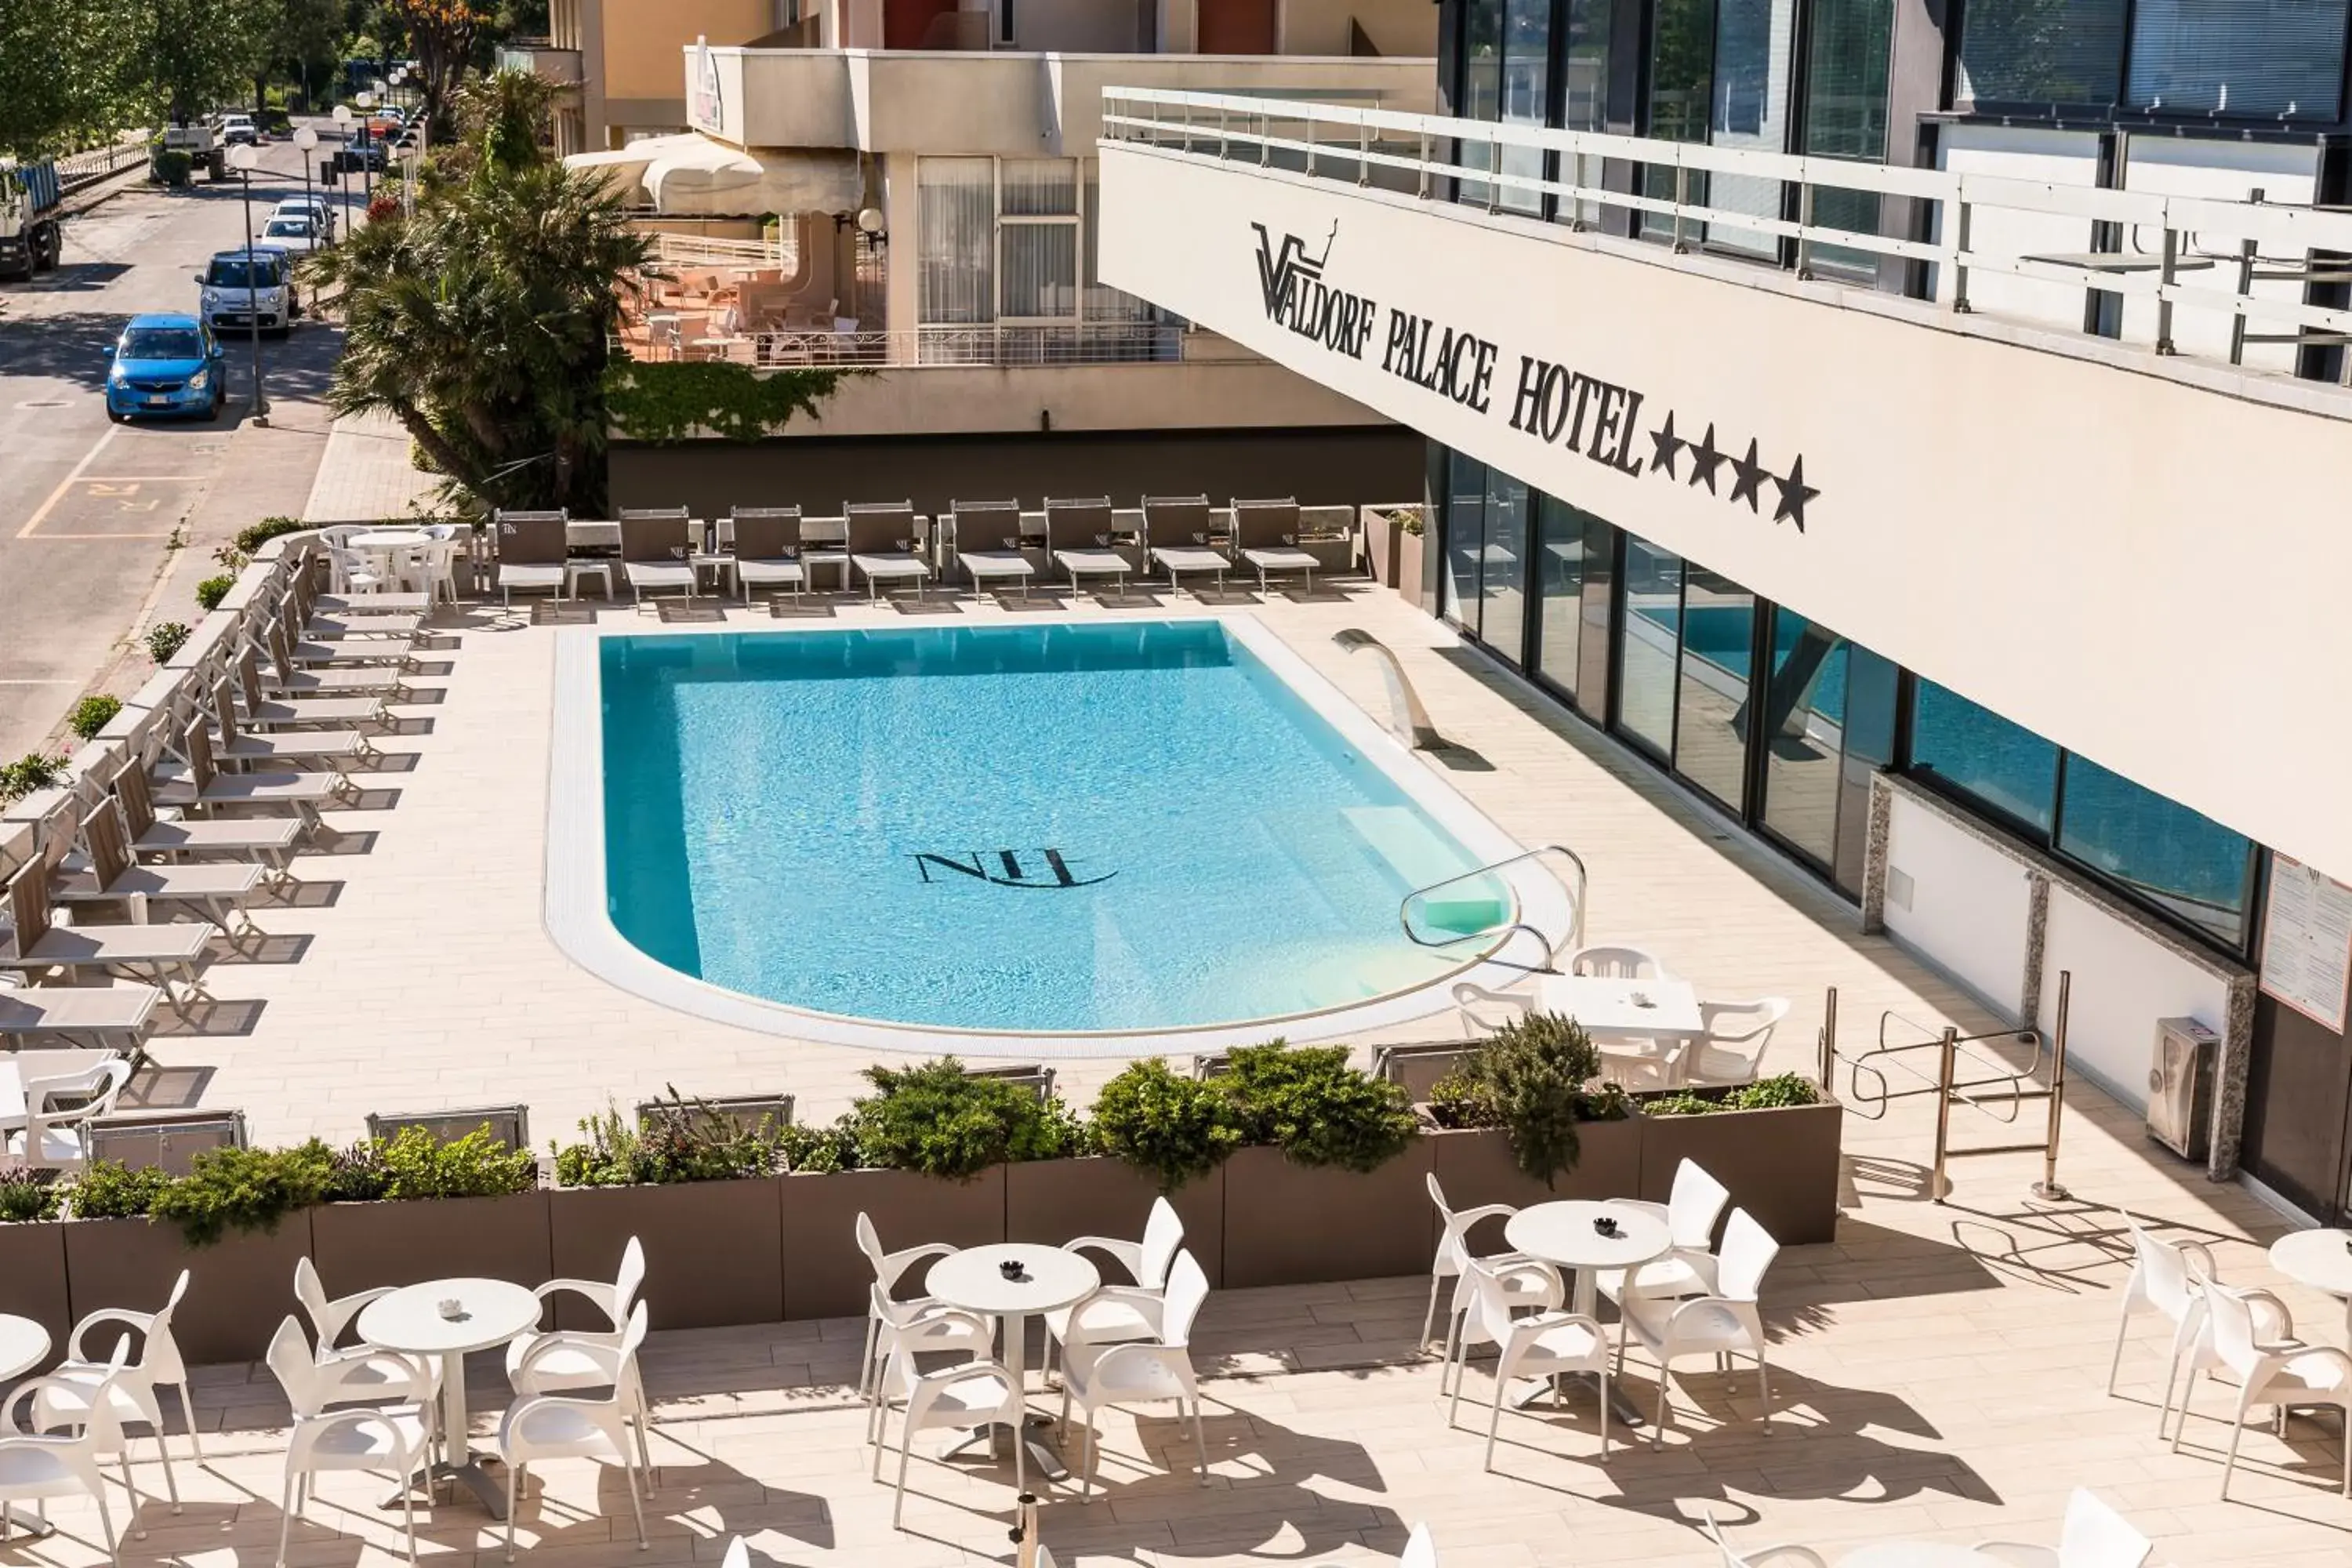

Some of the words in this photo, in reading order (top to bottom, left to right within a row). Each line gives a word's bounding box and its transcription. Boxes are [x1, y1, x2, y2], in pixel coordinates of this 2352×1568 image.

[1251, 218, 1376, 360] WALDORF
[1381, 308, 1498, 415] PALACE
[1508, 355, 1644, 477] HOTEL
